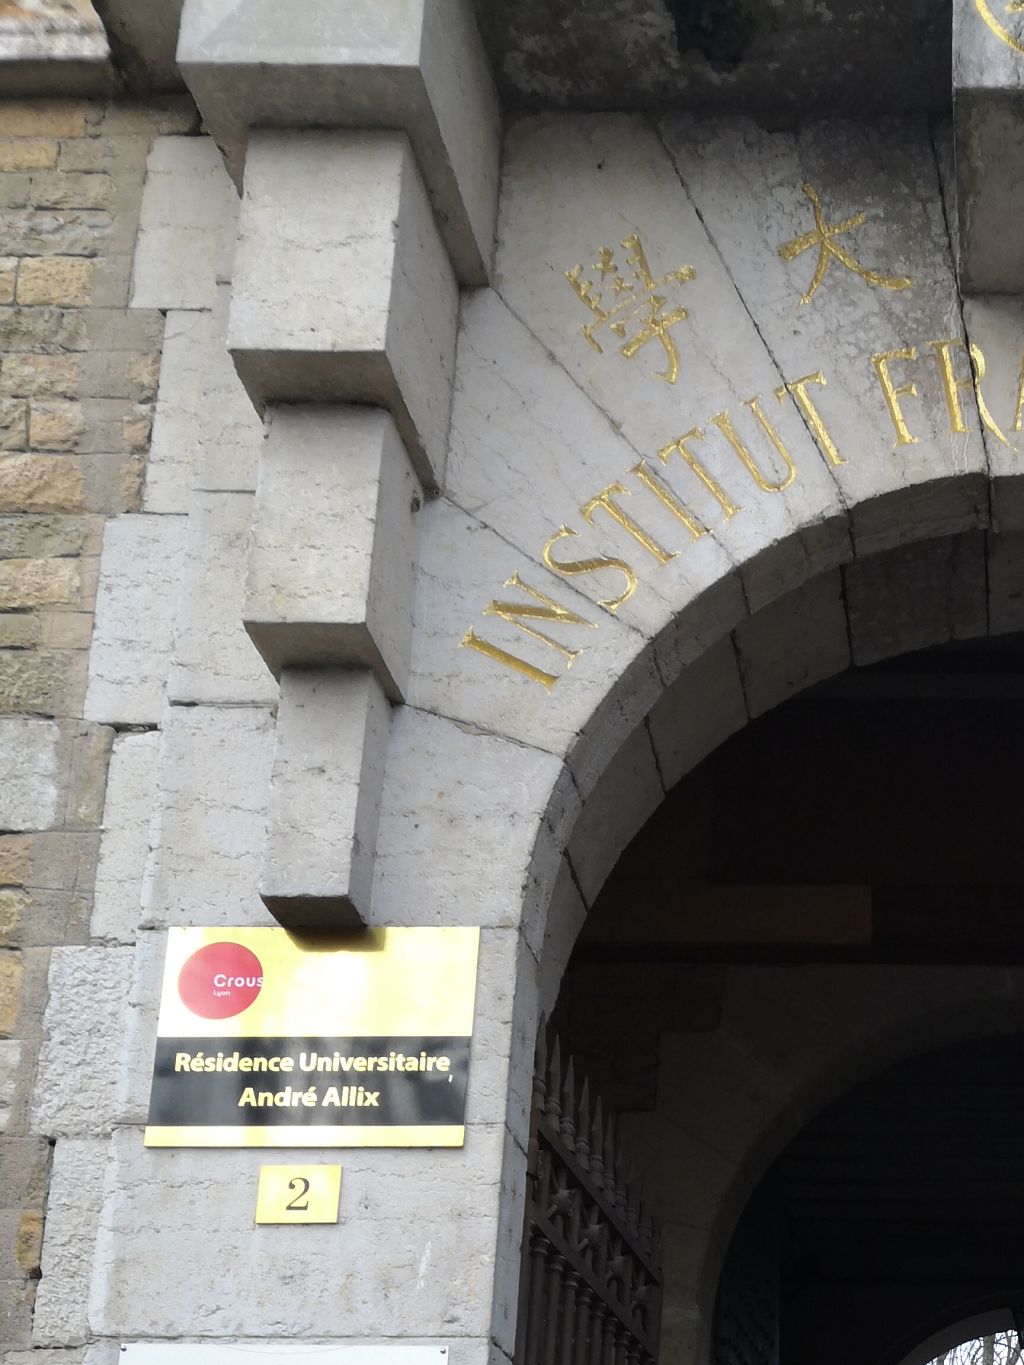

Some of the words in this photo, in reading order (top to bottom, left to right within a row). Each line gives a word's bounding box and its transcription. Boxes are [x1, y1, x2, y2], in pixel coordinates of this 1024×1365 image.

[458, 370, 846, 694] INSTITUT
[213, 973, 264, 988] Crous
[213, 989, 231, 998] Lyon
[174, 1051, 294, 1073] Résidence
[299, 1051, 451, 1073] Universitaire
[238, 1086, 317, 1107] André
[321, 1086, 380, 1107] Allix
[285, 1176, 310, 1212] 2
